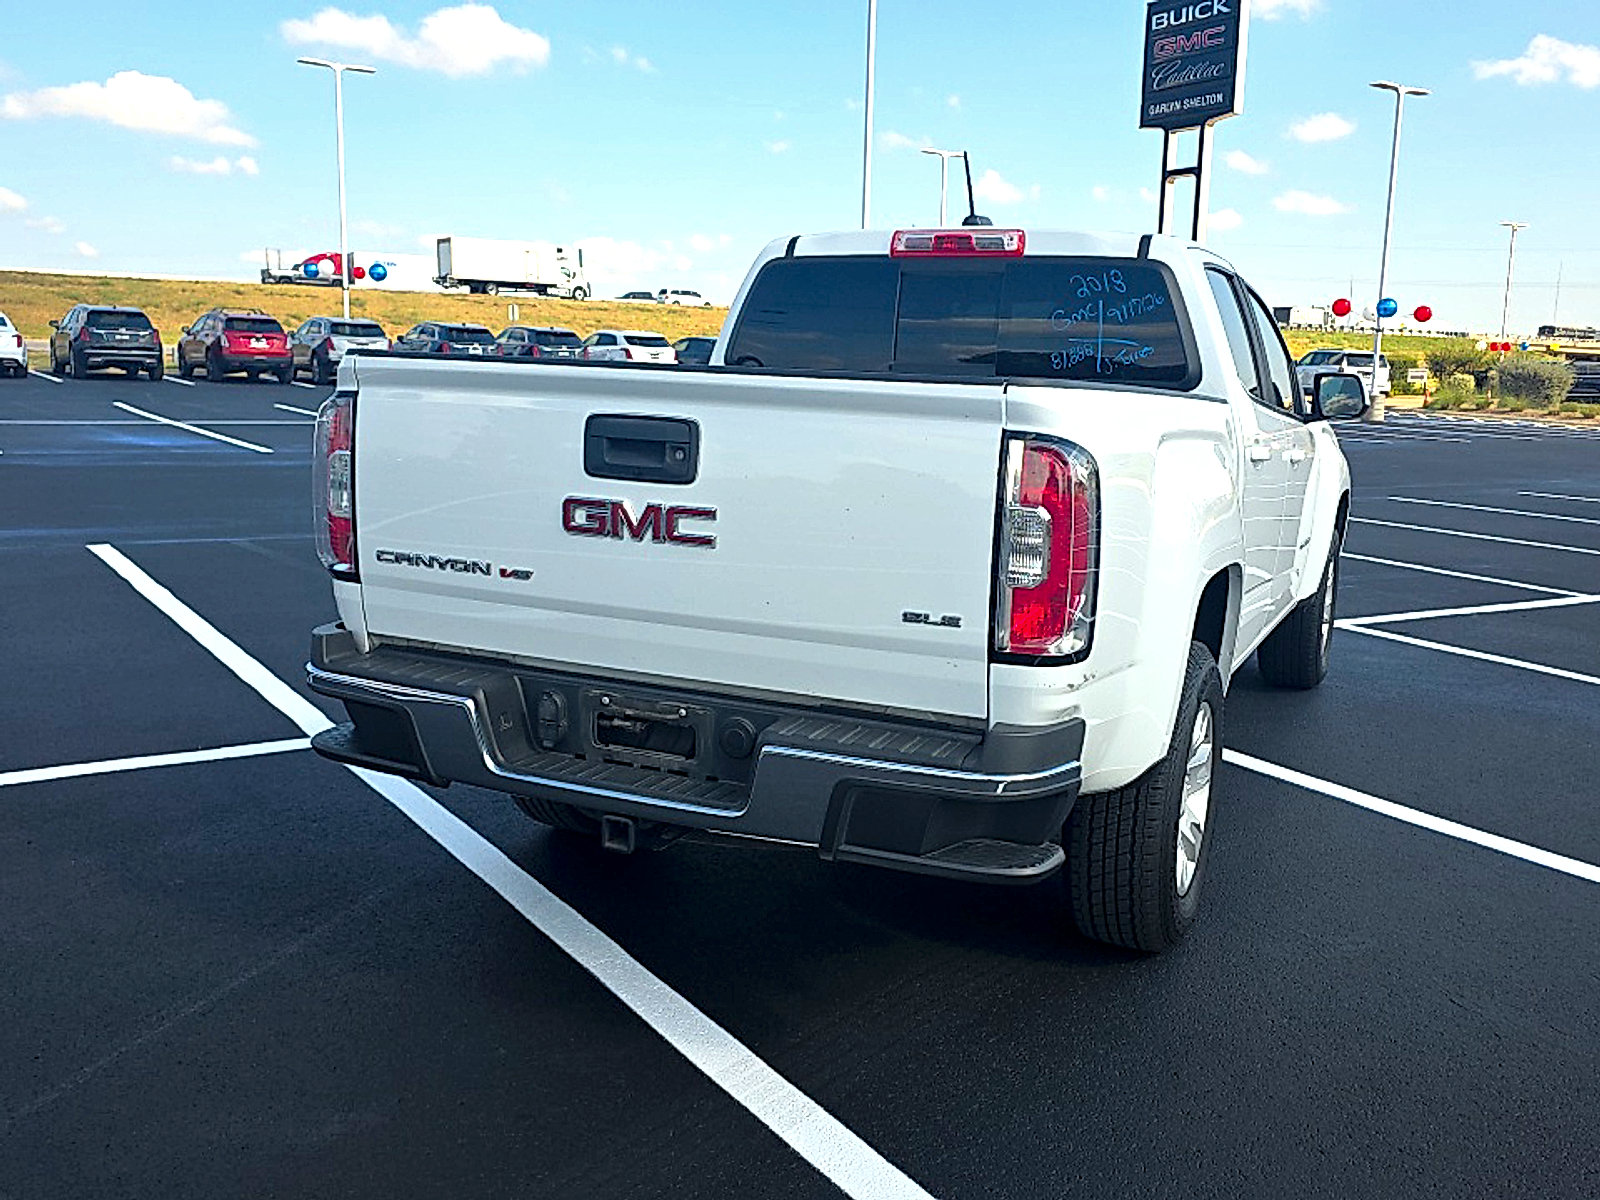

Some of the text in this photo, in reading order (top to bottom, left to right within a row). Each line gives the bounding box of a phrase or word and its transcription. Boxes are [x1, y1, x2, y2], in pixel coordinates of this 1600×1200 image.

[1152, 0, 1231, 30] BUICK
[1153, 25, 1226, 58] GMC
[1151, 60, 1225, 90] Cadillac
[1183, 93, 1223, 110] SHELTON
[1070, 269, 1126, 298] 2018
[562, 494, 717, 549] GMC
[375, 549, 492, 576] CANYON
[902, 611, 961, 628] SLE
